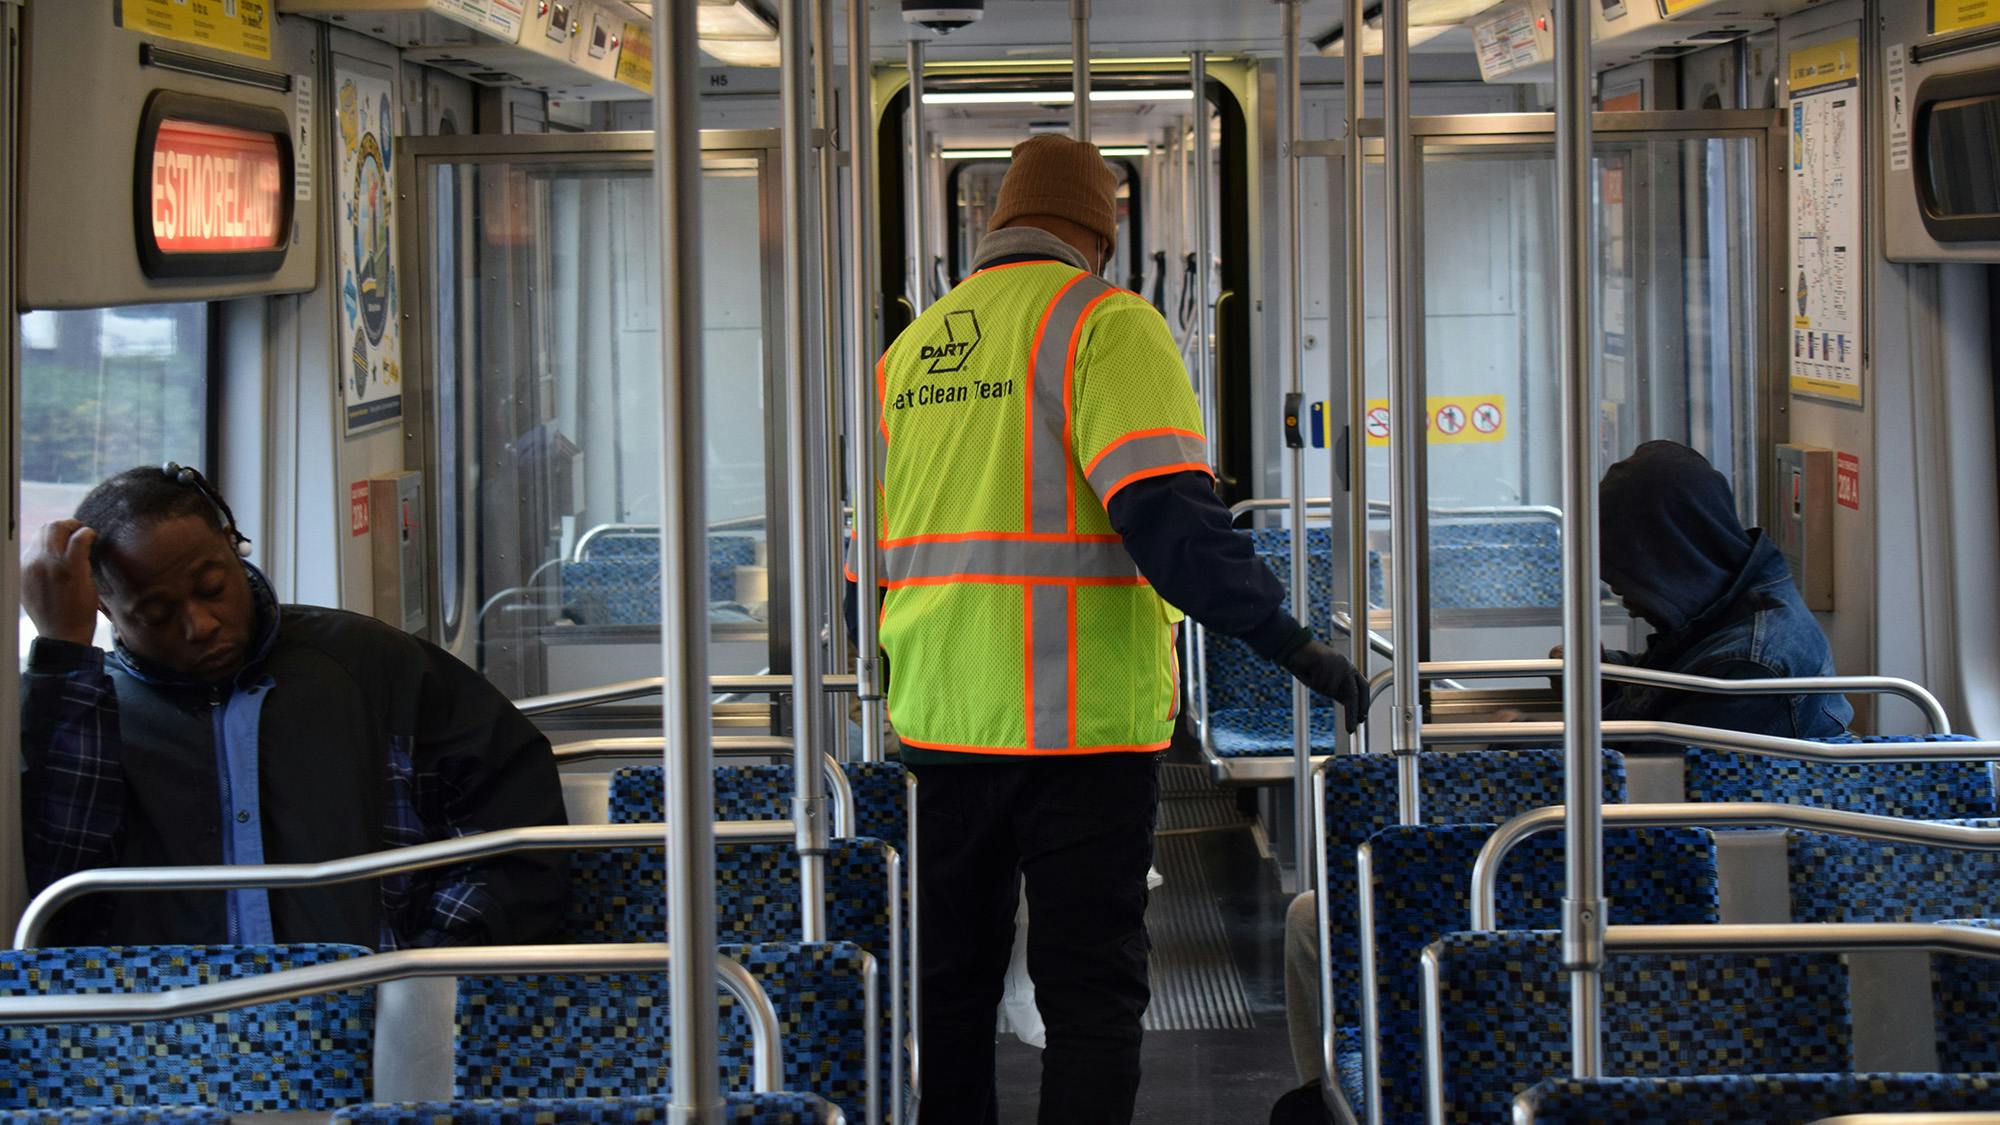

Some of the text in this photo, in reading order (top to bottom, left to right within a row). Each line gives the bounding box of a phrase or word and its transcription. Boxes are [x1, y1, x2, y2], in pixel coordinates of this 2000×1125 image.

[920, 342, 969, 360] DART
[893, 389, 914, 410] et
[919, 384, 968, 405] Clean
